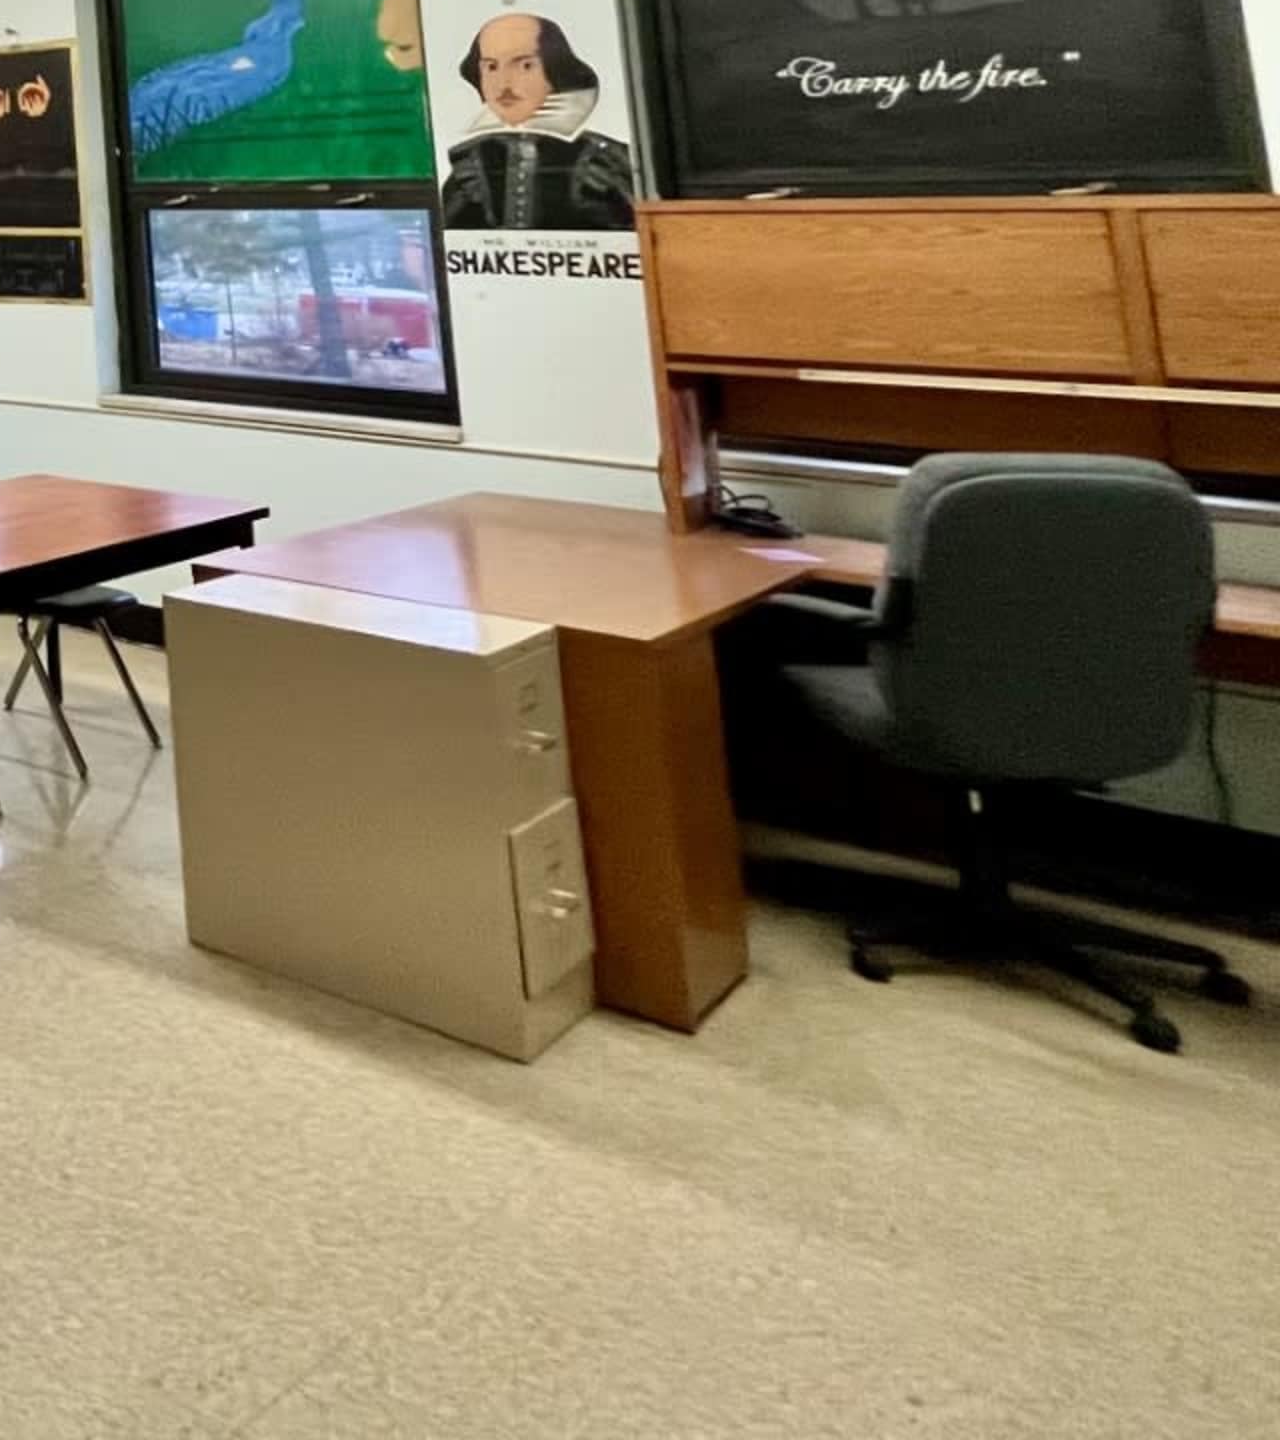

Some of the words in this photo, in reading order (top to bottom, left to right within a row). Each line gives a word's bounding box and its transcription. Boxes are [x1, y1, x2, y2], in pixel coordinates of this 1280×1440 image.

[919, 59, 971, 92] the
[525, 238, 599, 250] WILLIAM
[447, 250, 642, 280] SHAKESPEARE
